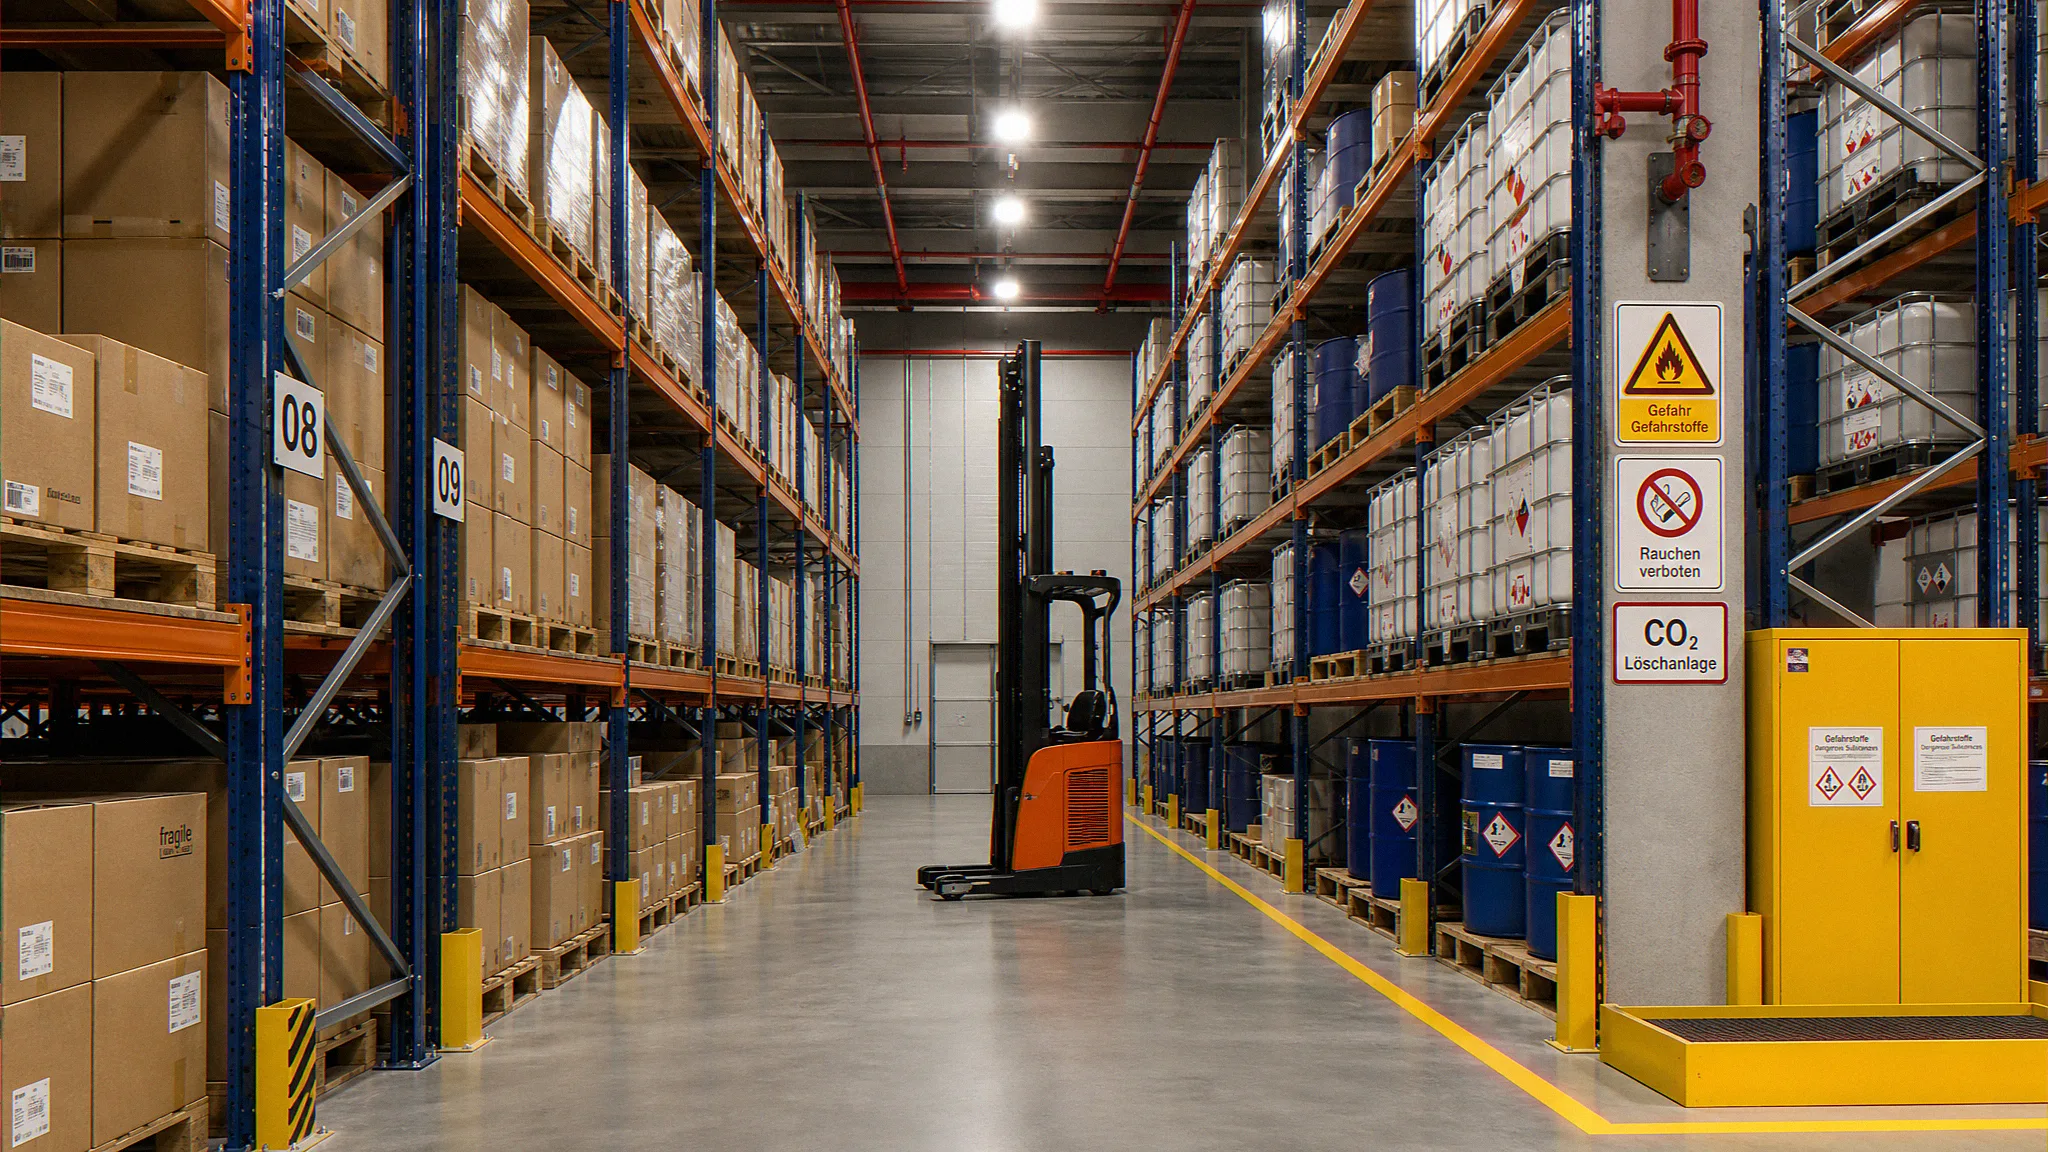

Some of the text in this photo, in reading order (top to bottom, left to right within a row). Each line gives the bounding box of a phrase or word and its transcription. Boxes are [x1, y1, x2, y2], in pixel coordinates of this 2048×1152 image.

[1648, 404, 1691, 416] Gefahr
[282, 394, 317, 458] 08
[1631, 420, 1708, 433] Gefahrstoffe
[438, 456, 461, 506] 09
[1640, 547, 1700, 560] Rauchen
[1639, 564, 1700, 577] verboten
[1625, 656, 1717, 674] Löschanlage
[1825, 734, 1870, 743] Gefahrstoffe
[160, 824, 192, 849] fragile
